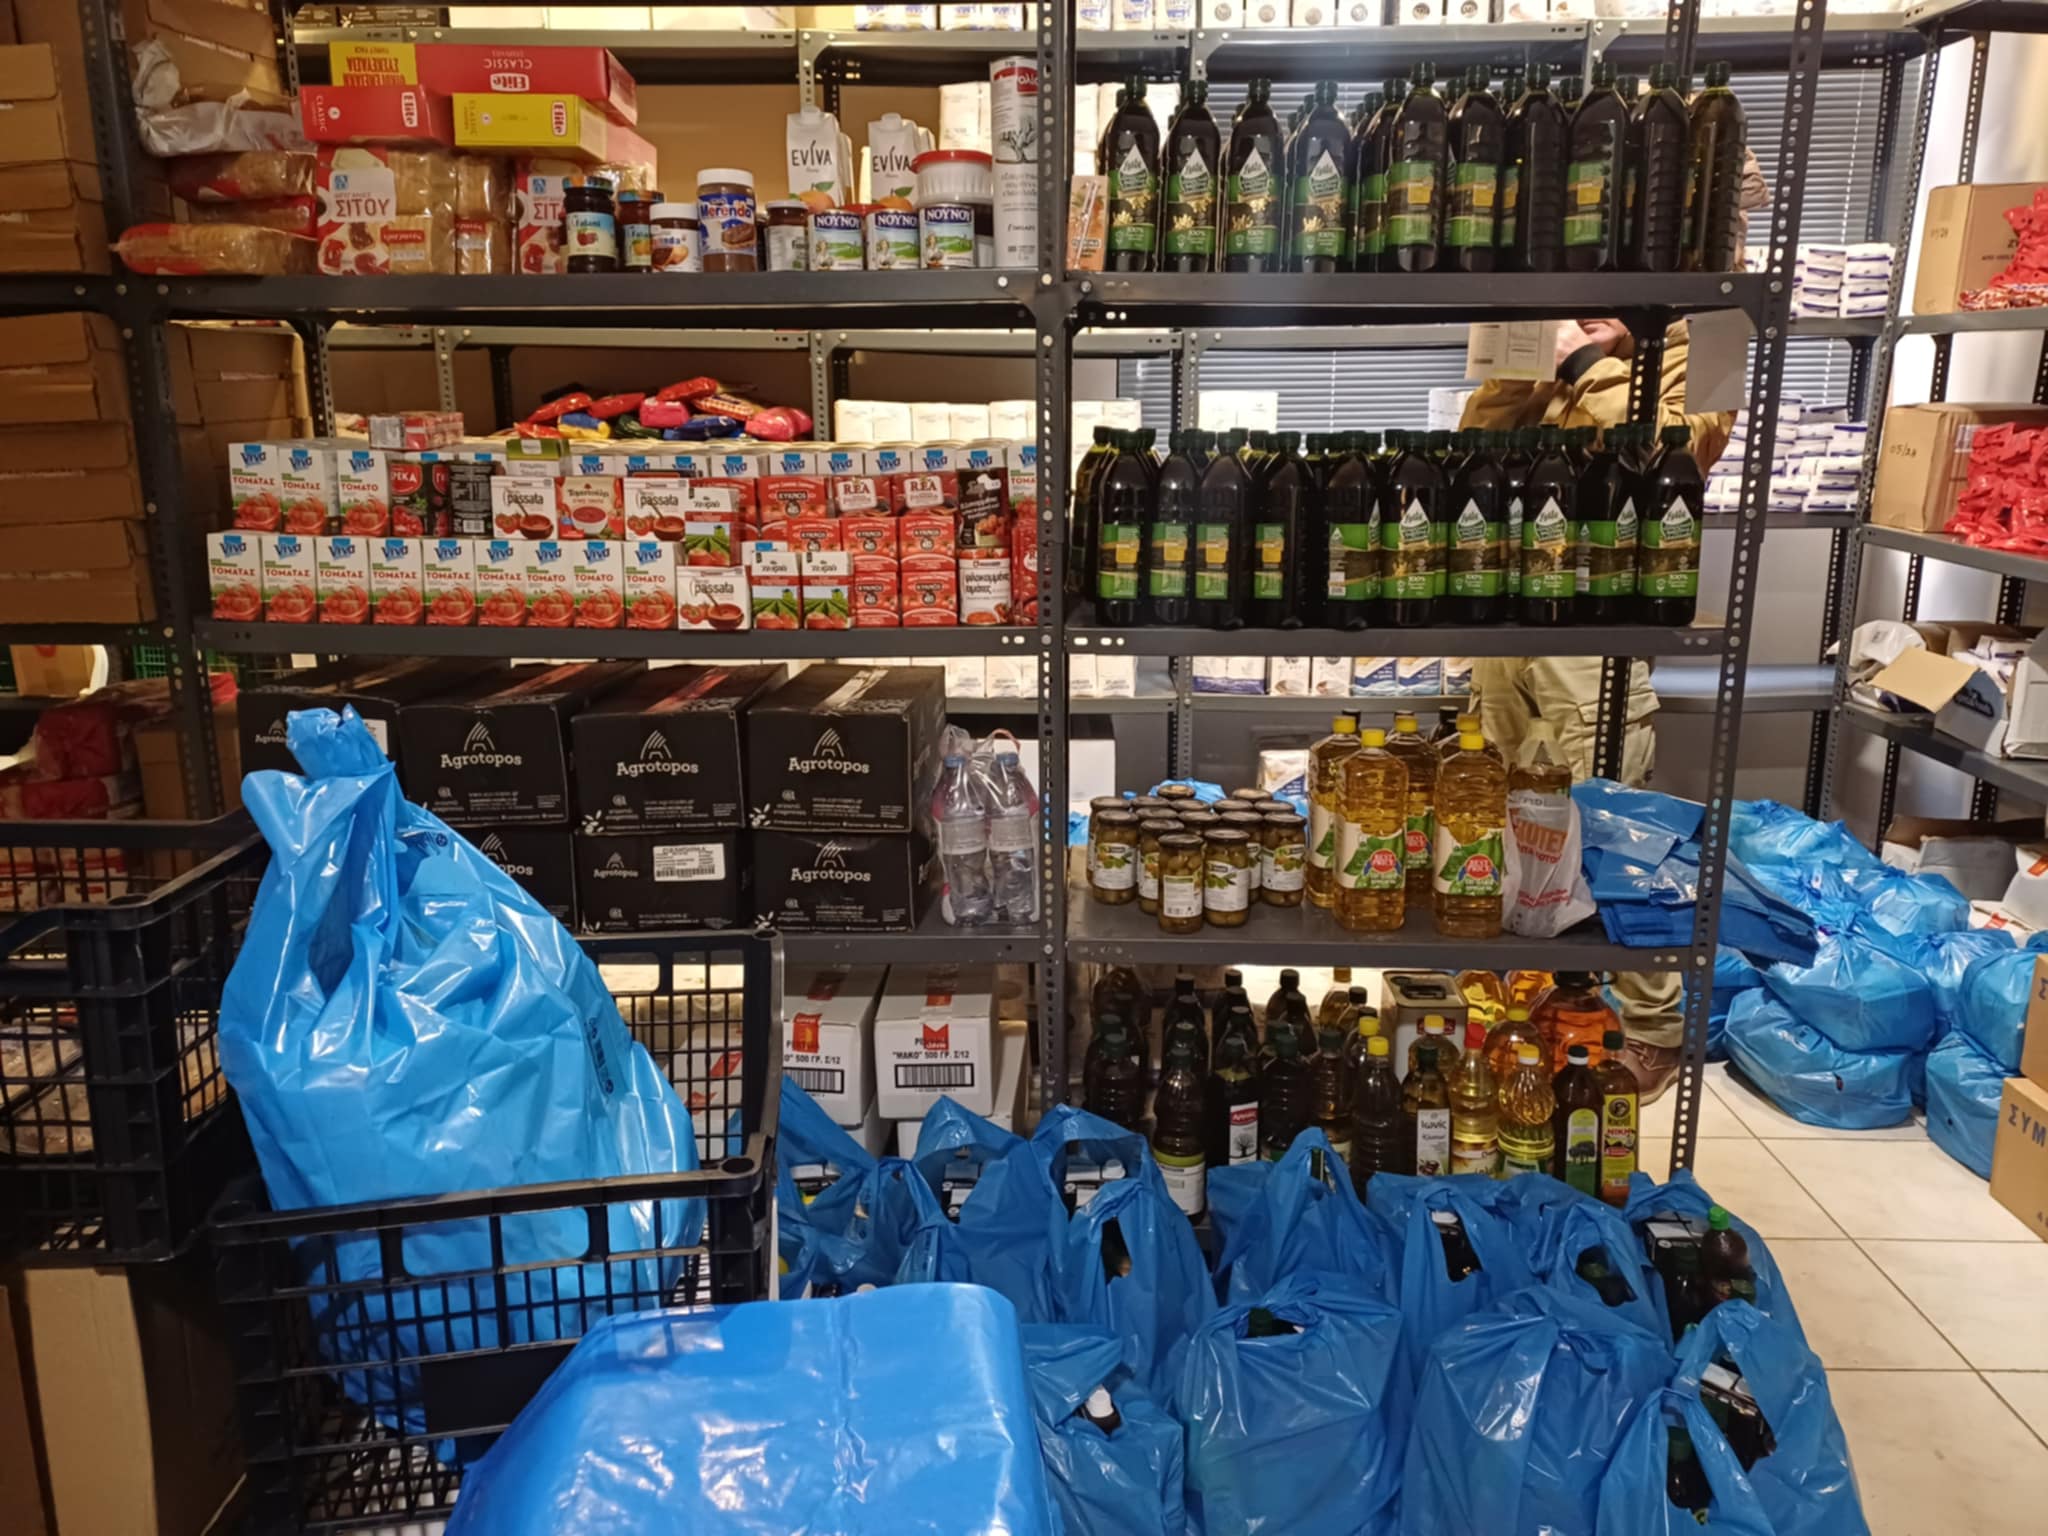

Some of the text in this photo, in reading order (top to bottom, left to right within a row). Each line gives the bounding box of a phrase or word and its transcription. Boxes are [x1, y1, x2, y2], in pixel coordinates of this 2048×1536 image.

[483, 58, 532, 69] CLASSIC
[492, 74, 527, 88] Elite
[403, 94, 416, 125] Elite
[553, 103, 565, 134] Elite
[335, 198, 391, 217] ΣΙΤΟΥ
[533, 202, 560, 220] ΣΙΤ
[877, 214, 918, 227] NOYNO
[844, 484, 871, 495] REA
[910, 480, 937, 491] REA
[507, 493, 545, 504] passata
[640, 494, 679, 506] passata
[694, 581, 734, 594] passata
[440, 753, 522, 769] Agrotopos
[788, 757, 870, 774] Agrotopos
[616, 761, 699, 777] Agrotopos
[593, 867, 639, 879] Agrotopos
[791, 867, 871, 883] Agrotopos
[795, 1055, 809, 1063] 500
[924, 1051, 939, 1059] 500
